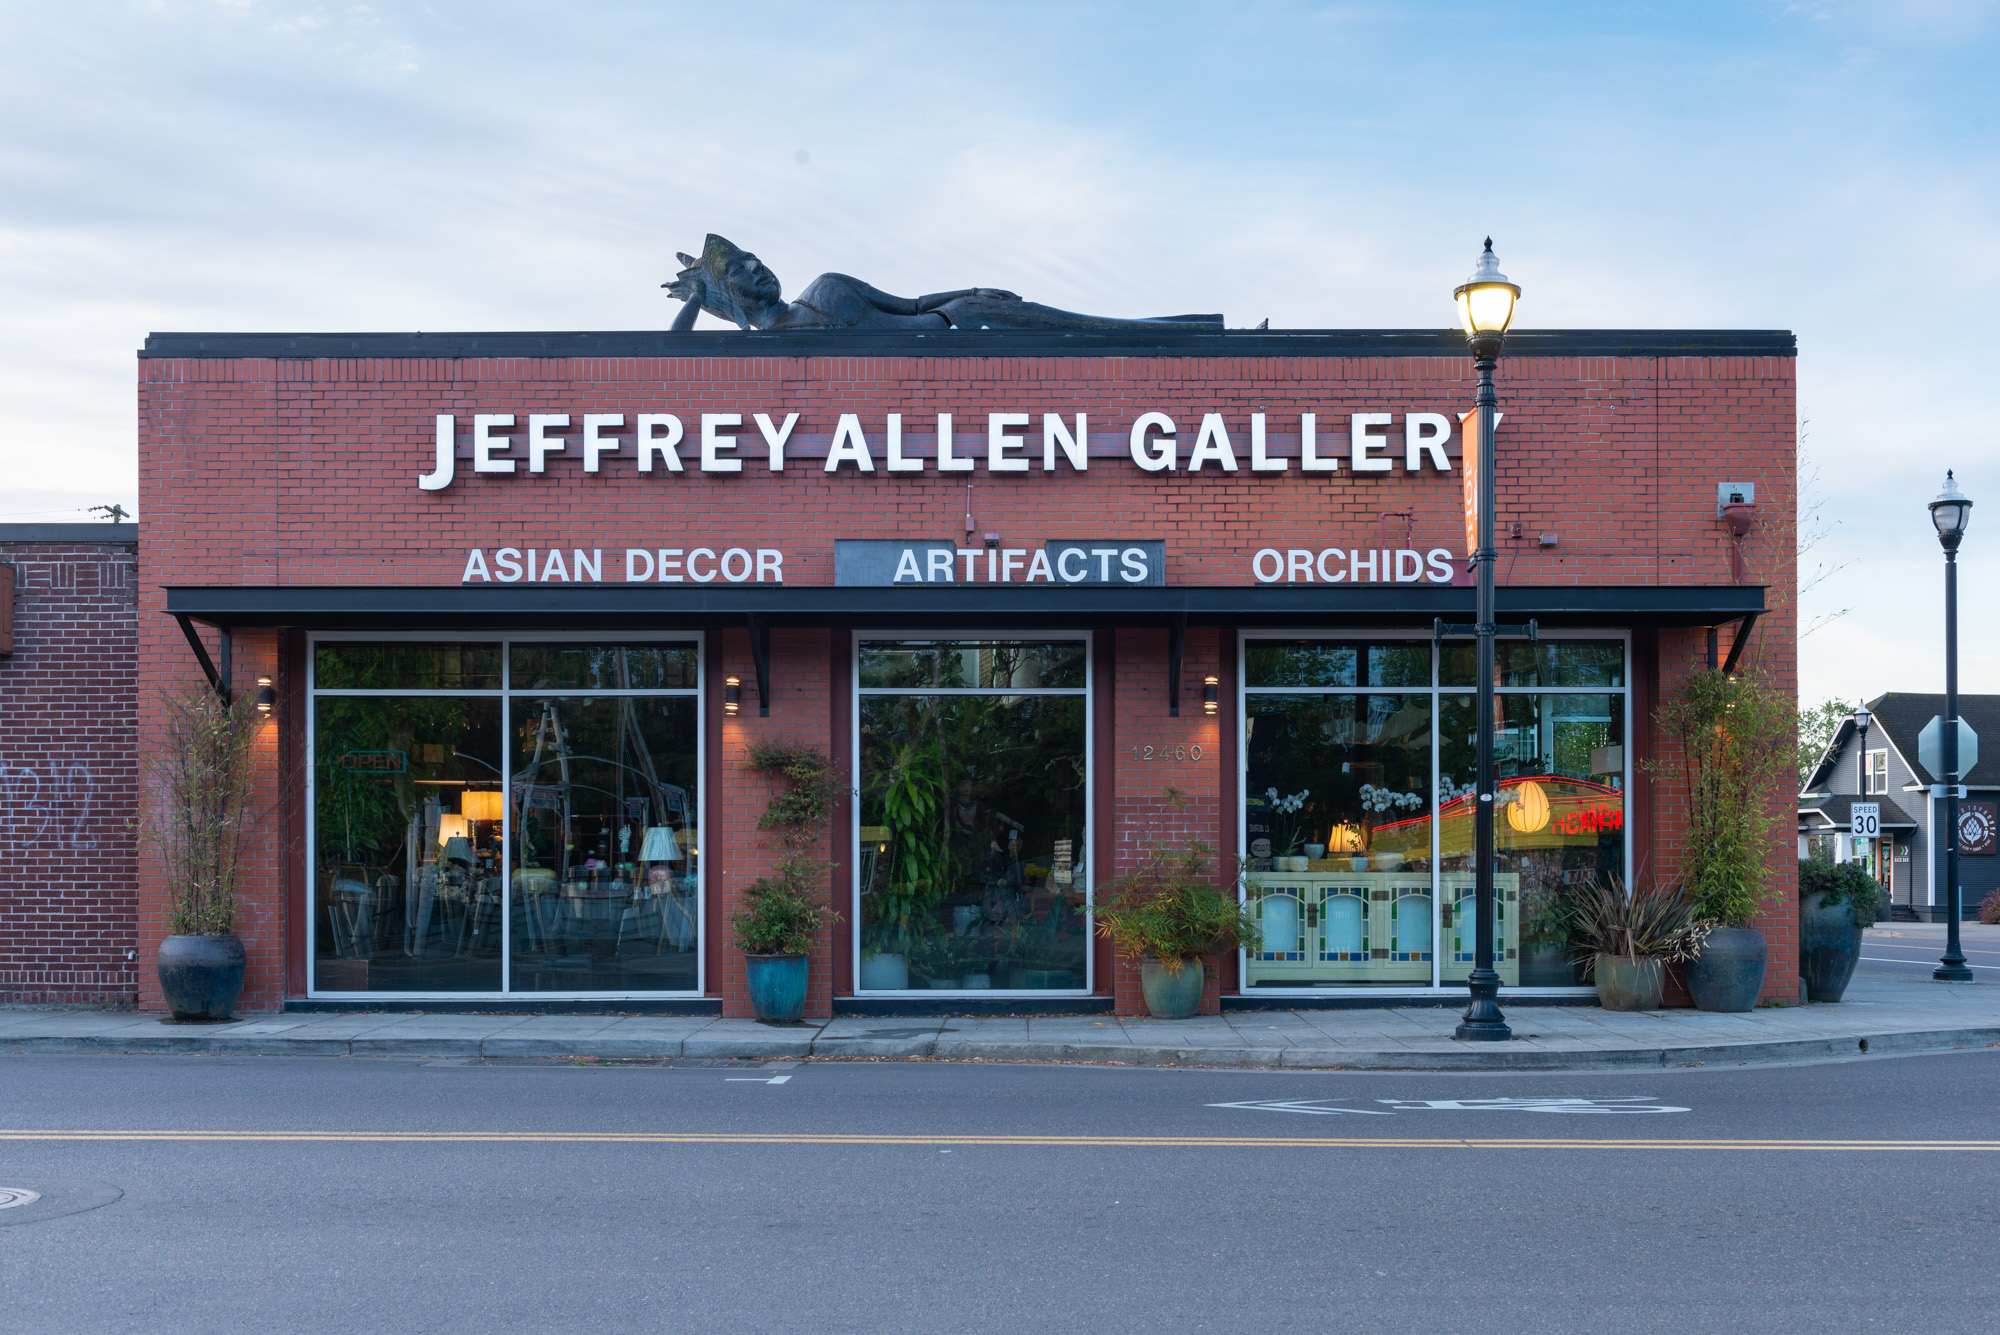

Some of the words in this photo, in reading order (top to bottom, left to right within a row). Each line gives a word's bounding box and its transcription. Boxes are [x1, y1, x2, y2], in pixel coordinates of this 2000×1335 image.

[418, 412, 801, 491] JEFFREY
[824, 412, 1088, 472] ALLEN
[1465, 460, 1476, 551] SHOP
[462, 547, 603, 583] ASIAN
[625, 547, 784, 583] DECOR
[892, 547, 1150, 583] ARTIFACTS
[1252, 547, 1455, 584] ORCHIDS
[341, 754, 401, 769] OPEN
[1131, 745, 1203, 761] 12460
[1853, 806, 1878, 814] SPEED
[1854, 815, 1877, 834] 30
